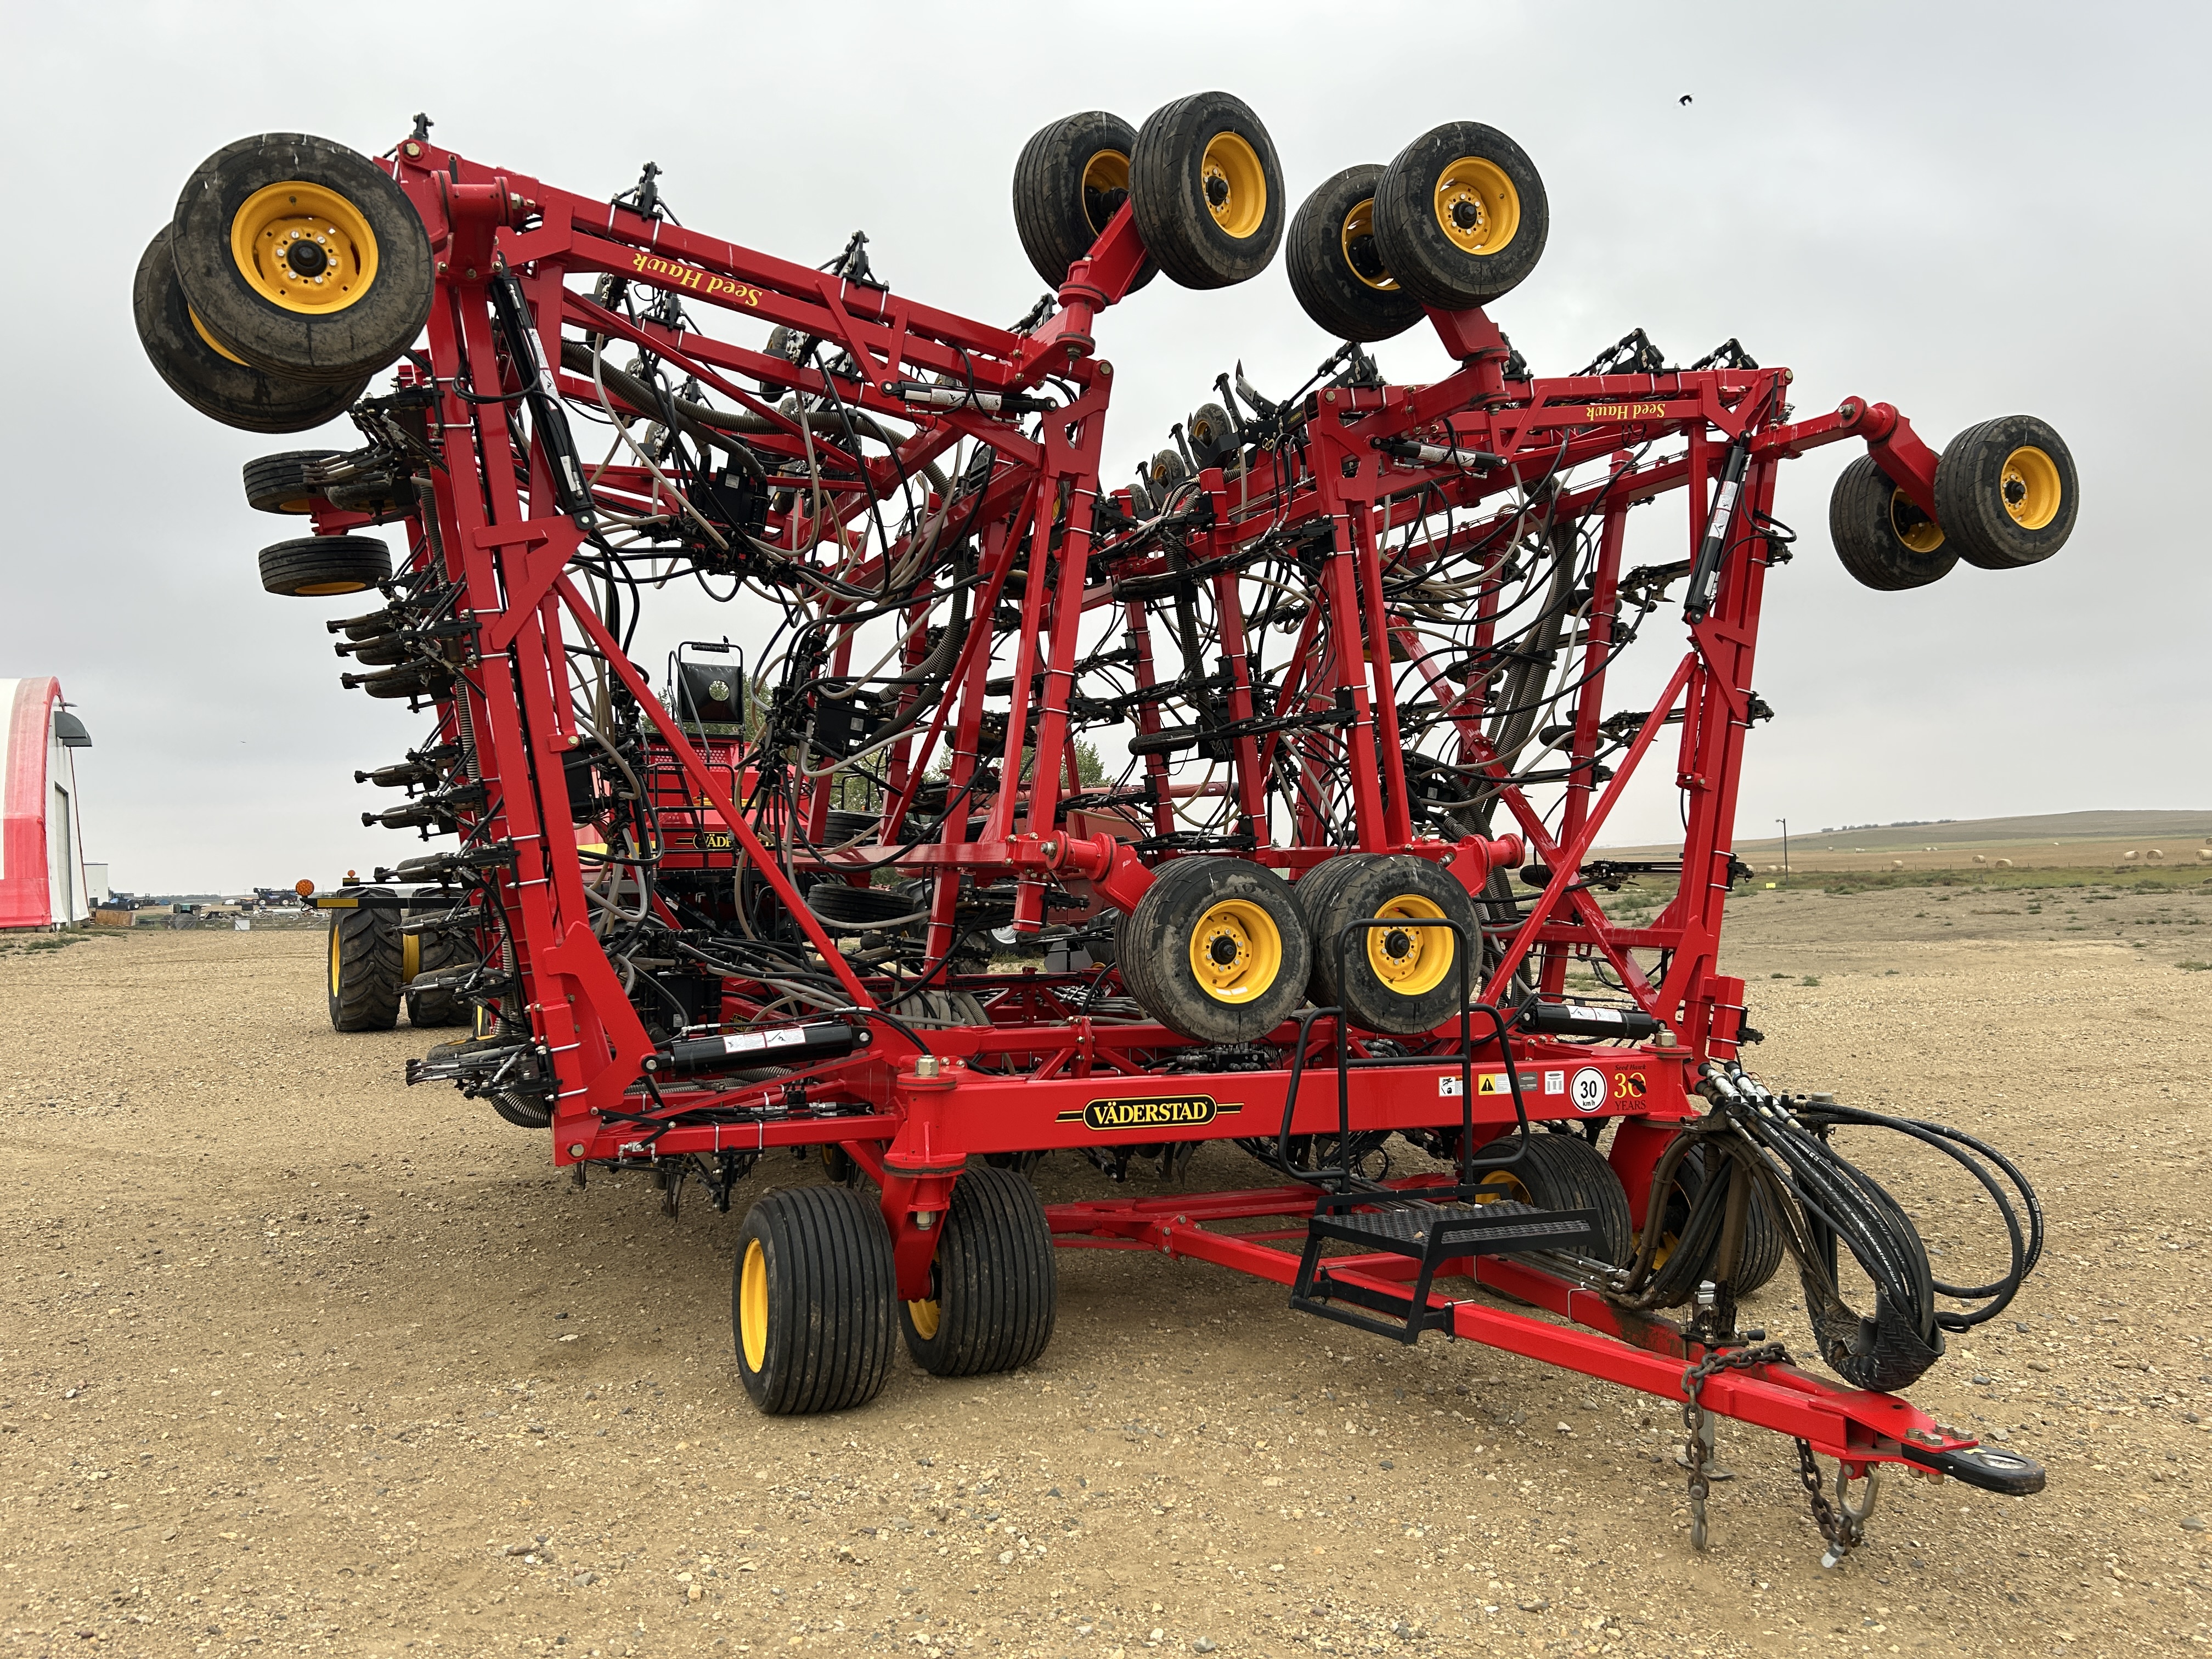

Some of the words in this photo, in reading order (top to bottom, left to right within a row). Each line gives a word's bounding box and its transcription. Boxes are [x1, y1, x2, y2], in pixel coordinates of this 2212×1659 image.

[633, 253, 703, 289] Hawk
[706, 276, 763, 307] Seed
[1585, 404, 1629, 421] Hawk
[1633, 403, 1666, 419] Seed
[1580, 1080, 1597, 1099] 30
[1614, 1072, 1646, 1098] 30
[1093, 1101, 1207, 1125] VÄDERSTAD
[1615, 1099, 1646, 1111] YEARS
